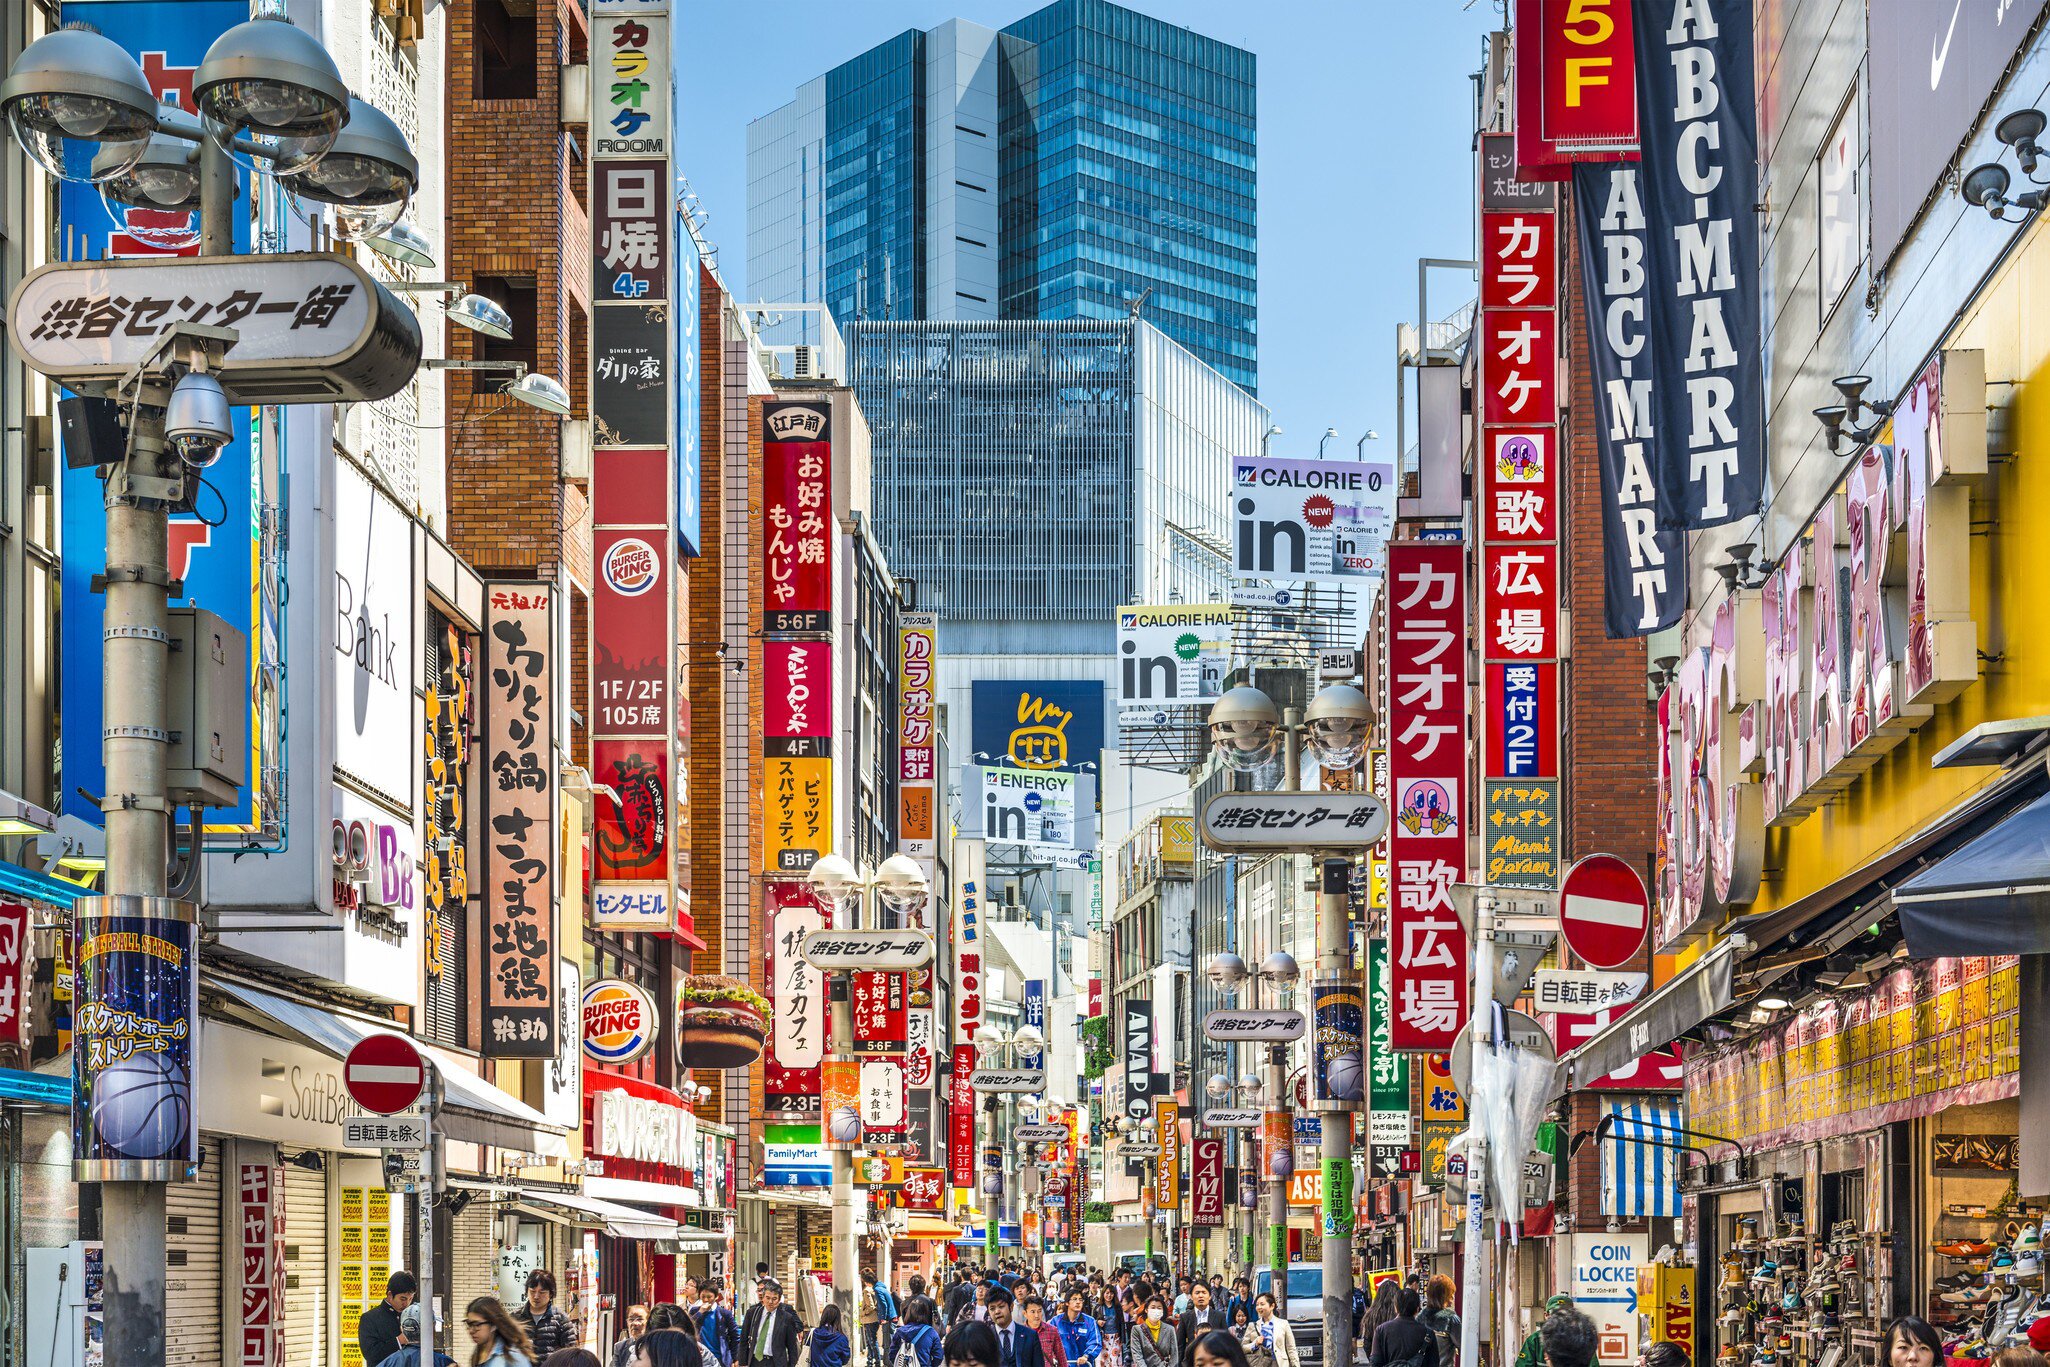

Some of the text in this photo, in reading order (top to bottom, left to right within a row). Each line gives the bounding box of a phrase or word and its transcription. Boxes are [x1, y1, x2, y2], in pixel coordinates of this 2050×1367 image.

[1563, 0, 1615, 108] 5F
[611, 20, 650, 136] カラオケ
[597, 139, 662, 153] ROOM
[600, 170, 660, 270] 日焼
[1665, 0, 1738, 521] ABC-MART
[612, 272, 650, 297] 4F
[29, 284, 356, 341] 渋谷センター街
[1497, 217, 1541, 414] カラオケ
[596, 355, 661, 384] ダリの家
[1600, 169, 1668, 629] ABC-MART
[772, 413, 820, 433] 江戸前
[1260, 468, 1362, 491] CALORIE
[797, 454, 825, 565] お好み焼
[1308, 507, 1332, 517] NEW!
[1238, 498, 1305, 573] in
[1336, 534, 1356, 555] in
[611, 548, 650, 568] BURGER
[769, 503, 794, 604] もんじゃ
[1343, 557, 1373, 570] ZERO
[612, 558, 651, 583] KING
[1495, 488, 1545, 655] 歌広場
[1234, 591, 1275, 602] hit-ad.co.jp
[903, 616, 932, 625] プリンスビル
[1139, 613, 1201, 628] CALORIE
[1179, 644, 1199, 653] NEW!
[1122, 640, 1177, 699] in
[1202, 664, 1218, 681] in
[1322, 652, 1353, 671] 白馬ビル
[1397, 562, 1458, 762] カラオケ
[903, 632, 932, 746] カラオケ
[491, 619, 547, 793] ちりとり鍋
[601, 705, 662, 727] 105席
[1506, 666, 1537, 774] 受付2F
[787, 739, 810, 755] 4F
[904, 748, 930, 762] 受付
[904, 762, 930, 779] 3F
[1001, 773, 1068, 792] ENERGY
[779, 761, 794, 847] スパゲッティ
[1492, 787, 1549, 804] パスタ
[648, 779, 664, 845] とうがらし料理
[804, 778, 819, 838] ピッツァ
[919, 795, 927, 832] Miyama
[986, 792, 1025, 840] in
[1212, 806, 1378, 828] 渋谷センター街
[1490, 809, 1553, 827] キッチン
[1043, 817, 1054, 830] in
[1050, 831, 1062, 839] 180
[1492, 835, 1552, 856] Miami
[910, 843, 923, 852] 2F
[1032, 852, 1078, 864] hit-ad.co.jp
[784, 852, 814, 869] B1F
[1487, 857, 1557, 881] Garden
[491, 806, 548, 1003] さつま地鶏
[596, 893, 667, 915] センタービル
[80, 933, 181, 968] BASKETBALL STREET
[809, 940, 926, 957] 渋谷センター街
[1397, 858, 1459, 1033] 歌広場
[872, 972, 887, 1028] お好み焼
[890, 973, 901, 1010] 江戸前
[1542, 979, 1639, 1005] 自転車を除く
[76, 1004, 187, 1037] バスケットボール
[583, 999, 640, 1020] BURGER
[857, 988, 870, 1037] もんじゃ
[491, 1018, 548, 1043] 米助
[583, 1012, 642, 1038] KING
[1210, 1018, 1301, 1031] 渋谷センター街
[90, 1039, 166, 1067] ストリート
[1129, 1011, 1148, 1093] ANAP
[884, 1066, 893, 1110] ケーキと
[973, 1075, 1041, 1086] 渋谷センター街
[870, 1088, 881, 1122] お食事
[1429, 1086, 1458, 1111] 松
[1207, 1112, 1262, 1122] 渋谷センター街
[1372, 1123, 1406, 1131] ねぎ塩焼き
[348, 1123, 421, 1142] 自転車を除く
[1018, 1129, 1066, 1137] 渋谷センター街
[768, 1147, 818, 1160] FamilyMart
[957, 1144, 969, 1153] 2F
[1161, 1110, 1176, 1204] プリクラのメッカ
[957, 1158, 969, 1167] 3F
[1450, 1162, 1464, 1172] 75
[788, 1172, 798, 1184] 酒
[904, 1171, 941, 1199] すき家
[957, 1172, 969, 1181] 4F
[1196, 1142, 1219, 1213] GAME
[342, 1206, 363, 1215] ¥50,000
[369, 1206, 390, 1215] ¥50,000
[1194, 1215, 1221, 1224] 渋谷会館
[342, 1244, 363, 1253] ¥50,000
[369, 1244, 390, 1253] ¥50,000
[1590, 1245, 1631, 1261] COIN
[242, 1166, 269, 1362] キャッシュ
[1579, 1266, 1638, 1282] LOCKE
[342, 1283, 363, 1292] ¥50,000
